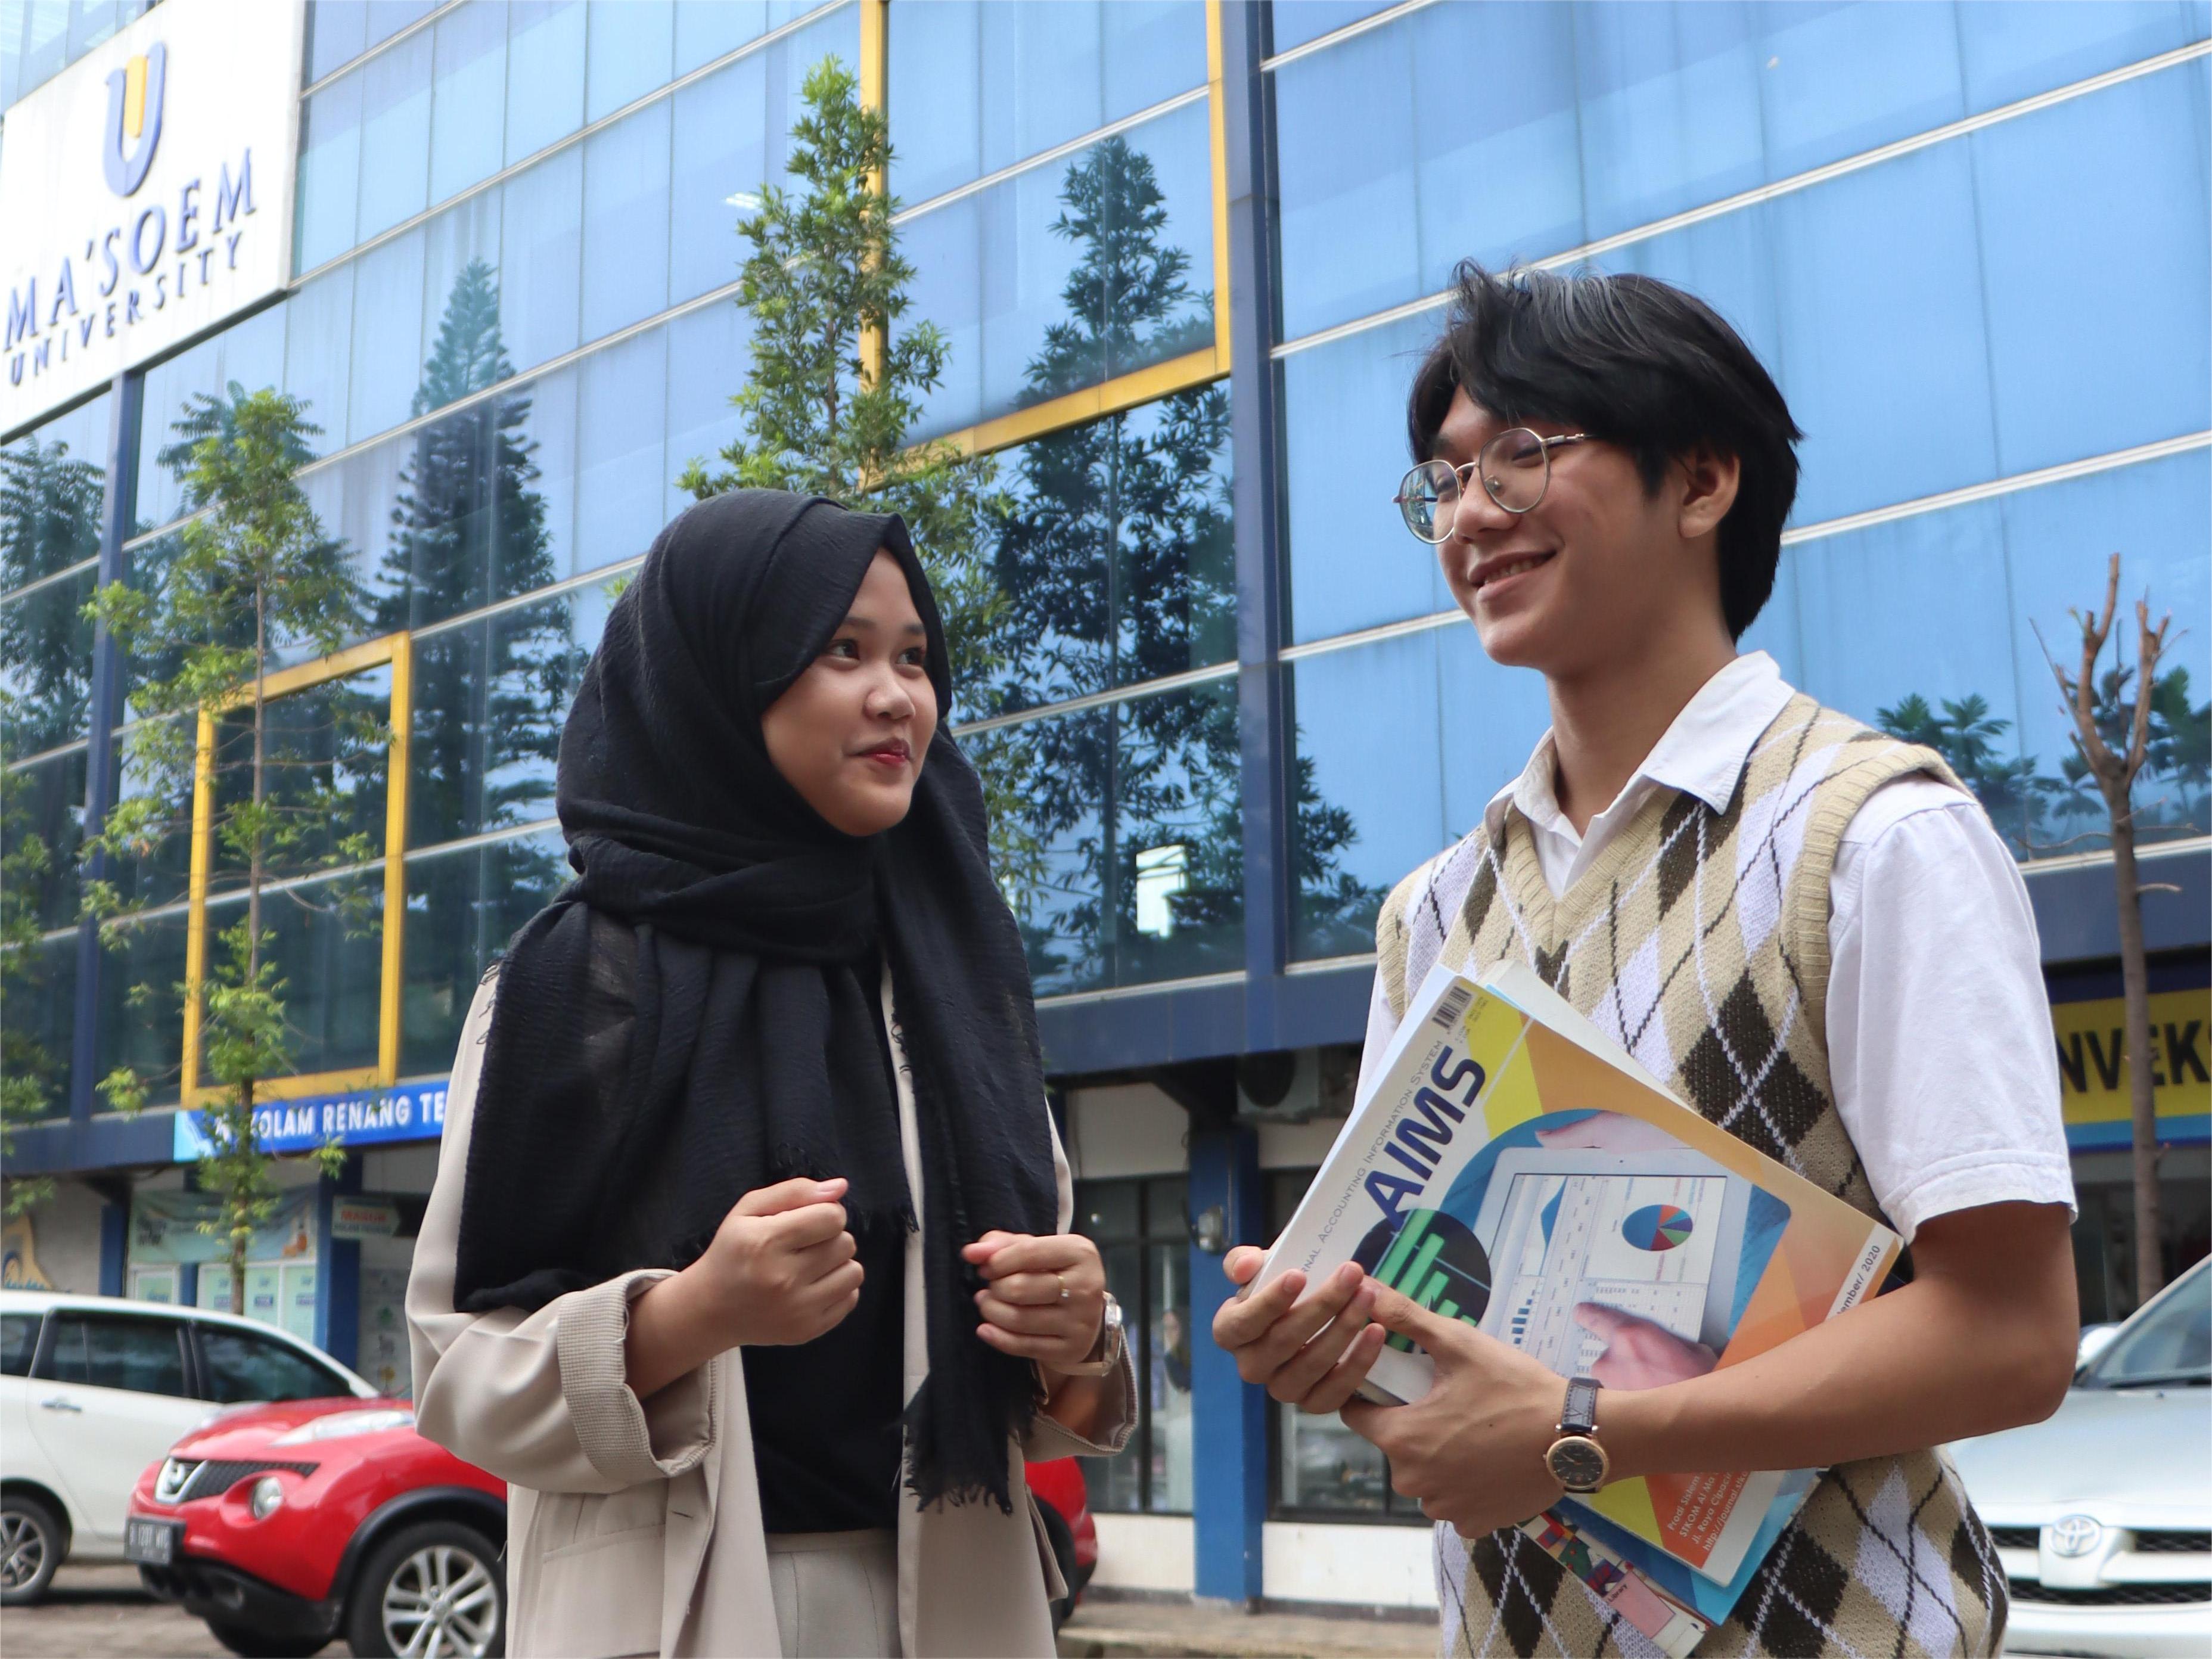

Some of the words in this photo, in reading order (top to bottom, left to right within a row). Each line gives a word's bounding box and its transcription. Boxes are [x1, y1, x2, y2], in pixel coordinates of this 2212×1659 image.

[4, 147, 255, 352] MA'SOEM
[10, 231, 242, 387] UNIVERSITY
[2055, 1021, 2212, 1093] NVK
[322, 1095, 411, 1132] RENANG
[1363, 1045, 1486, 1232] AIMS
[1861, 1245, 1881, 1272] 2020
[1667, 1506, 1685, 1531] Prodi
[1680, 1475, 1700, 1505] Sistem
[1697, 1508, 1714, 1532] Raya
[1608, 1583, 1628, 1602] Library
